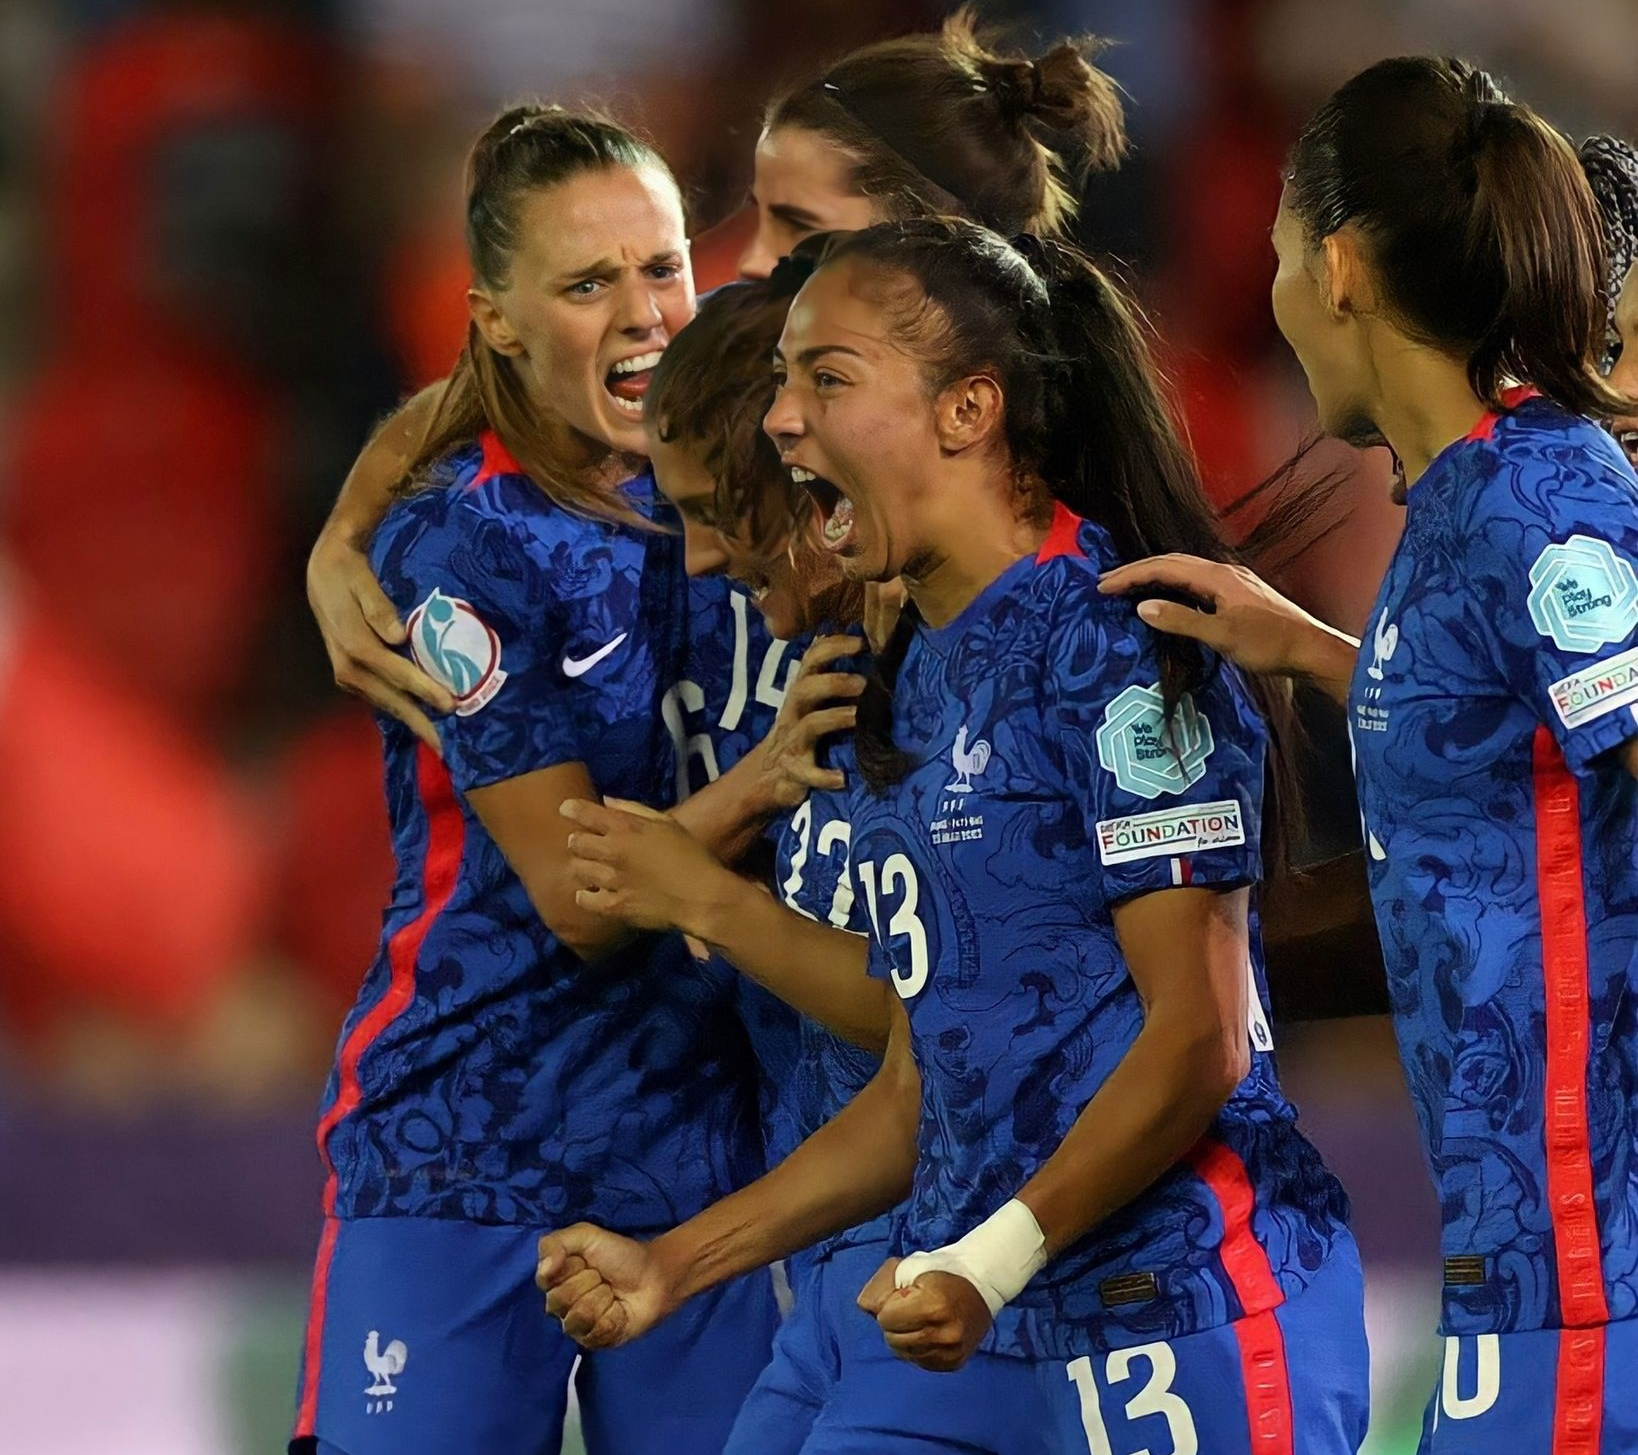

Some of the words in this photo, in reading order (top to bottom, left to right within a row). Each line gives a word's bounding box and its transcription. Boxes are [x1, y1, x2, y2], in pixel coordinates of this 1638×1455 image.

[718, 589, 802, 731] 14
[1101, 814, 1239, 850] FOUNDATION
[857, 853, 929, 999] 13
[1066, 1340, 1199, 1455] 13
